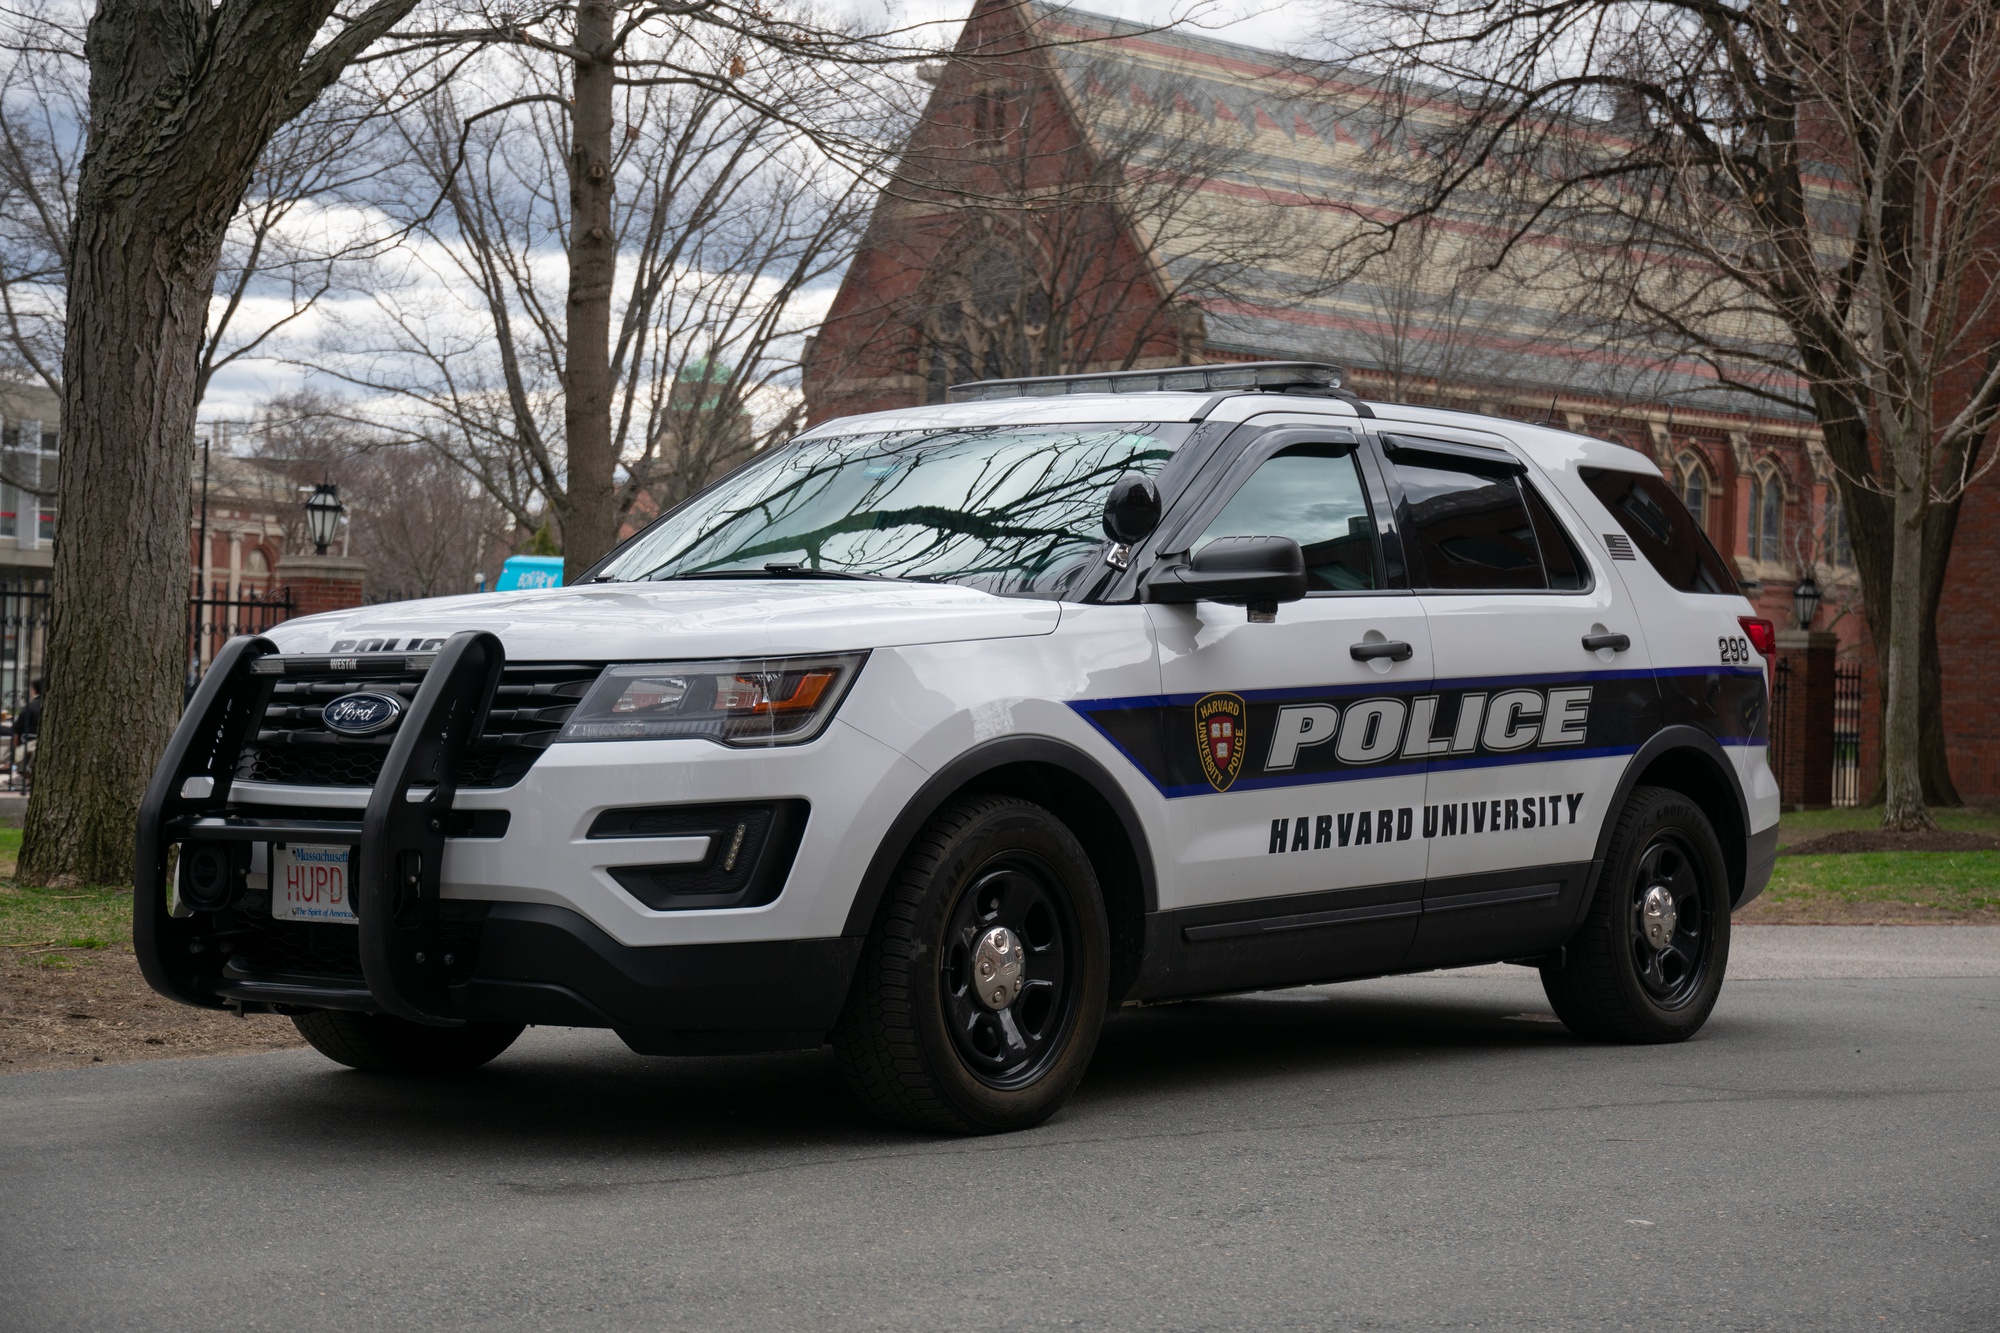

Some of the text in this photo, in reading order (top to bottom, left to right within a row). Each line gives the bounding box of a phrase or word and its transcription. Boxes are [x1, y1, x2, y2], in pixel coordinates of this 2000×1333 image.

[329, 638, 448, 653] POLIC
[1718, 636, 1750, 665] 298
[1200, 699, 1240, 719] HARVARD
[1263, 686, 1594, 772] POLICE
[1198, 721, 1223, 785] UNIVERSITY
[1227, 728, 1243, 775] POLICE
[1268, 793, 1584, 854] HARVARD UNIVERSITY
[295, 848, 349, 863] Massachusett
[286, 864, 343, 905] HUPD
[296, 907, 353, 918] The Spirit of America
